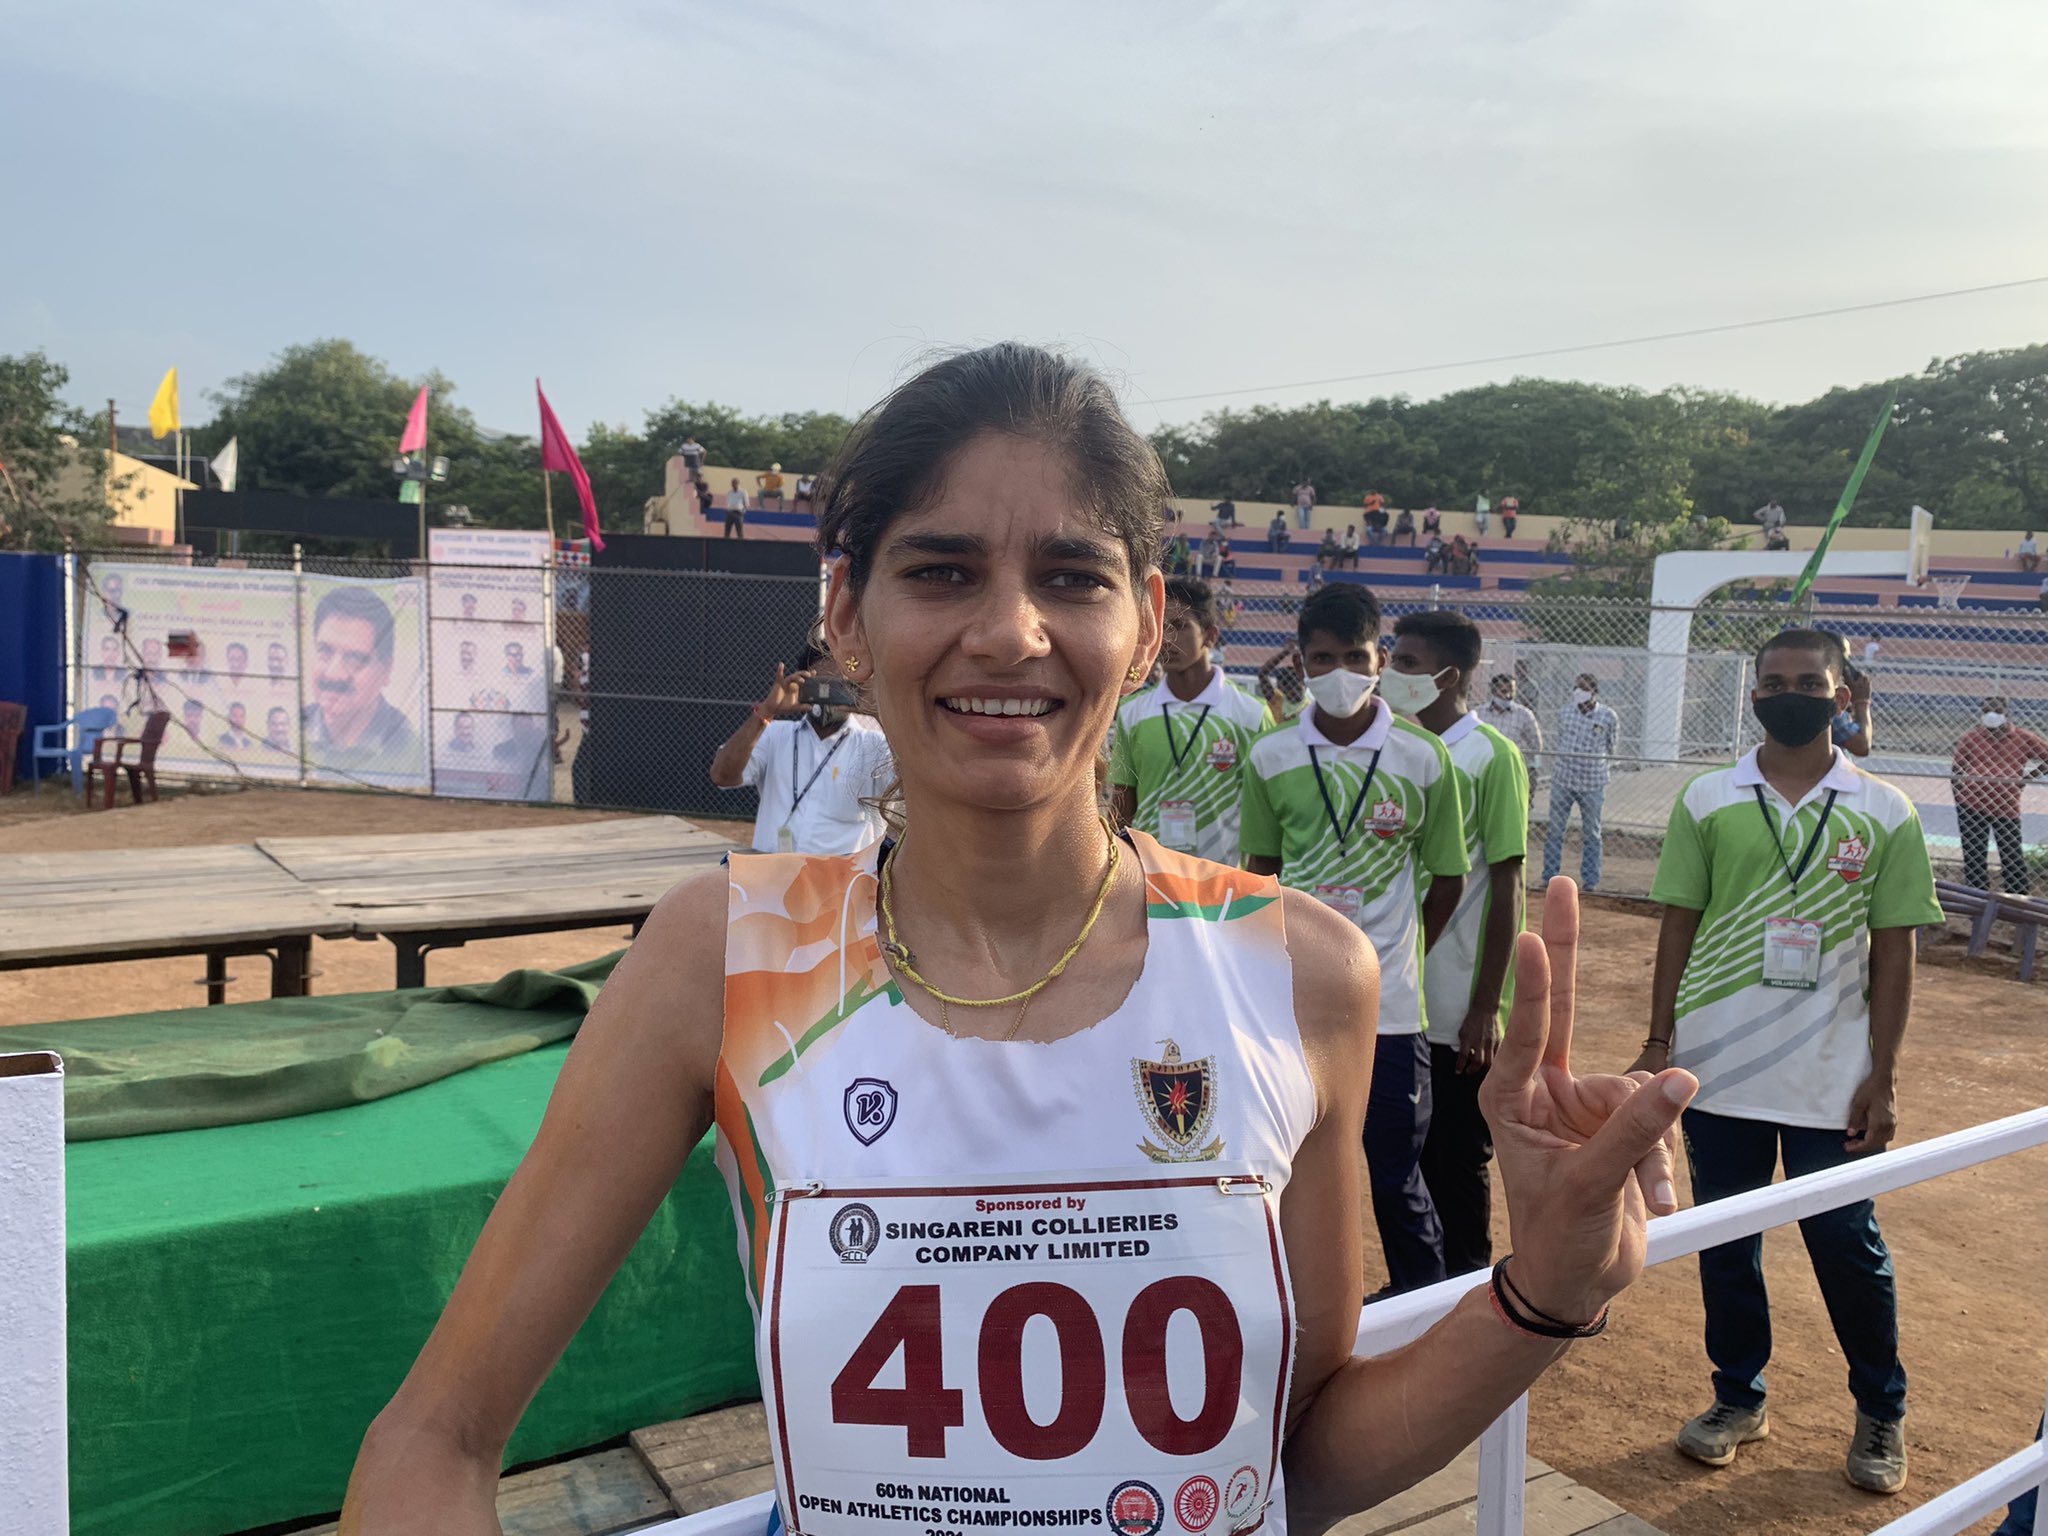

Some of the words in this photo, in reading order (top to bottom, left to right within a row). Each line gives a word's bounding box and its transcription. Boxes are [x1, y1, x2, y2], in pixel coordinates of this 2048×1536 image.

[975, 1197, 1062, 1214] Sponsored
[1067, 1196, 1086, 1211] by
[885, 1219, 1023, 1240] SINGARENI
[1031, 1213, 1179, 1236] COLLIERIES
[841, 1250, 867, 1262] SCCL
[915, 1243, 1040, 1264] COMPANY
[1047, 1240, 1150, 1260] LIMITED
[831, 1275, 1244, 1461] 400
[875, 1482, 914, 1499] 60th
[917, 1485, 1011, 1504] NATIONAL
[798, 1494, 843, 1515] OPEN
[846, 1501, 943, 1523] ATHLETICS
[946, 1508, 1103, 1527] CHAMPIONSHIPS
